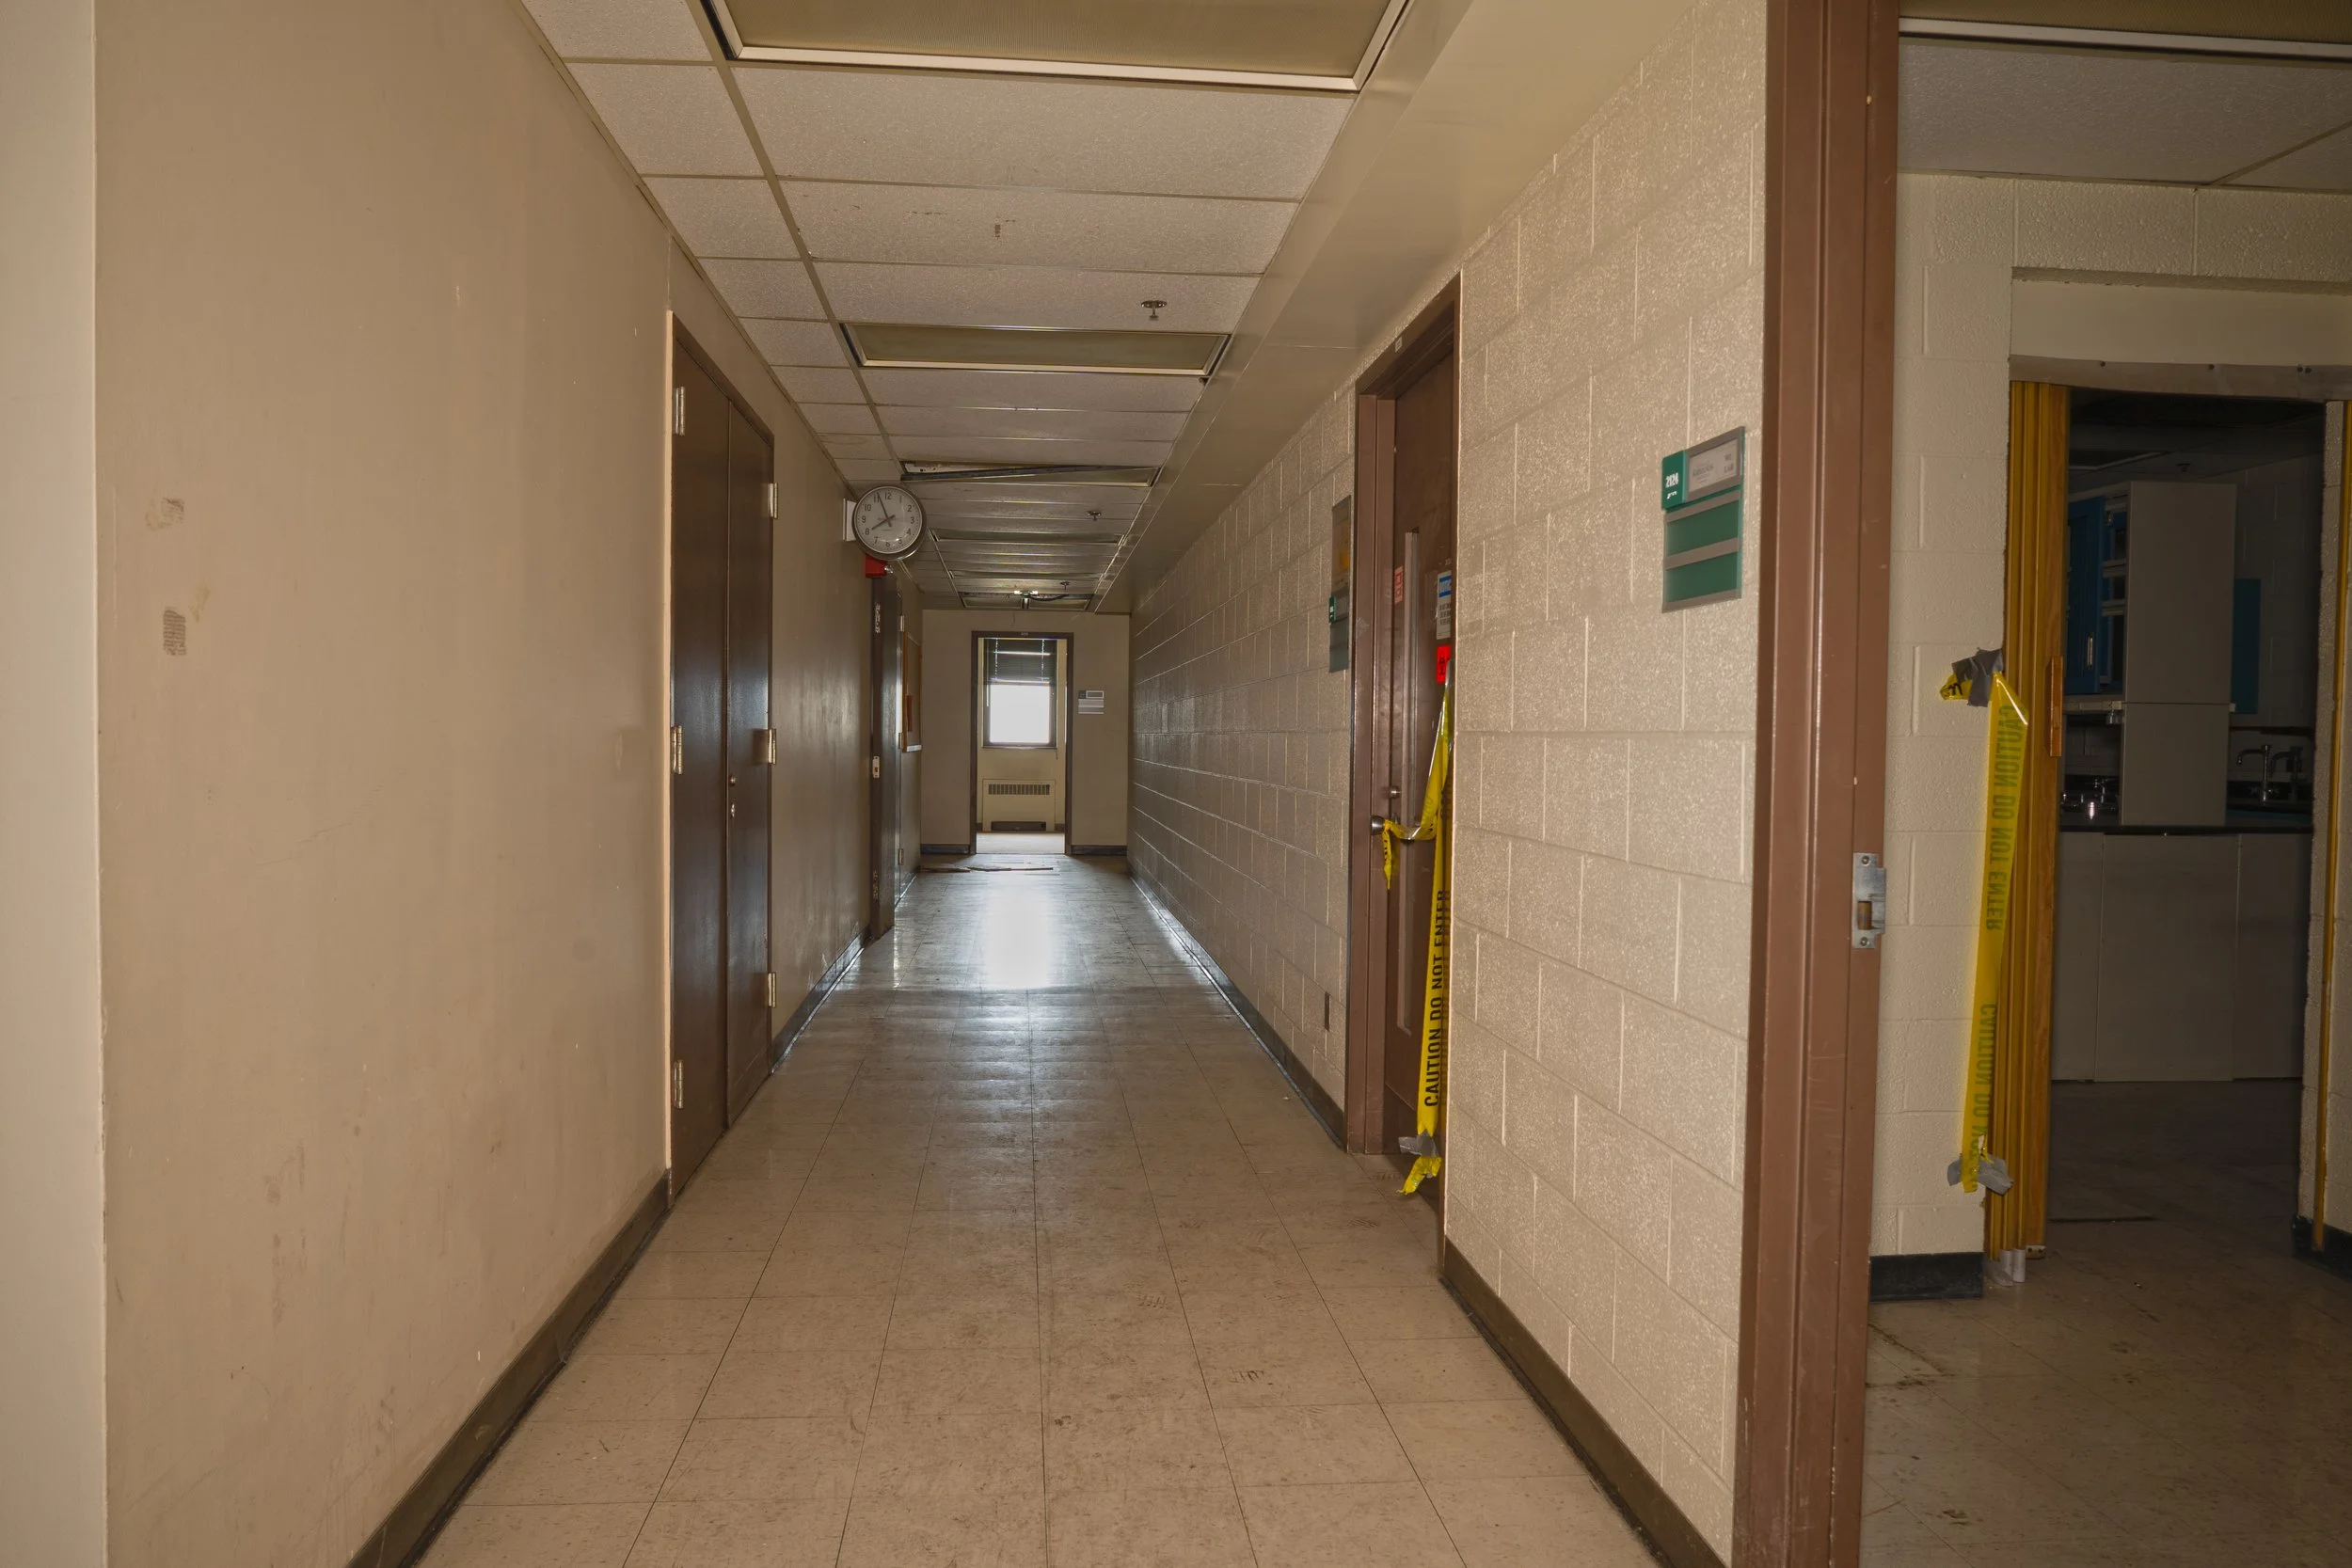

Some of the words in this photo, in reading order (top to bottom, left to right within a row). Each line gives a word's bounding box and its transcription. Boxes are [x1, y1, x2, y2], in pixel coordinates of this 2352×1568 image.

[885, 490, 893, 500] 12
[865, 503, 872, 513] 10
[907, 504, 913, 513] 2
[861, 515, 866, 524] 9
[910, 516, 915, 525] 3
[866, 527, 870, 535] 8
[906, 528, 912, 536] 4
[874, 536, 880, 545] 7
[1434, 889, 1445, 947] ENTER
[1431, 955, 1443, 990] NOT
[1429, 997, 1441, 1021] DO
[1424, 1029, 1440, 1107] CAUTION
